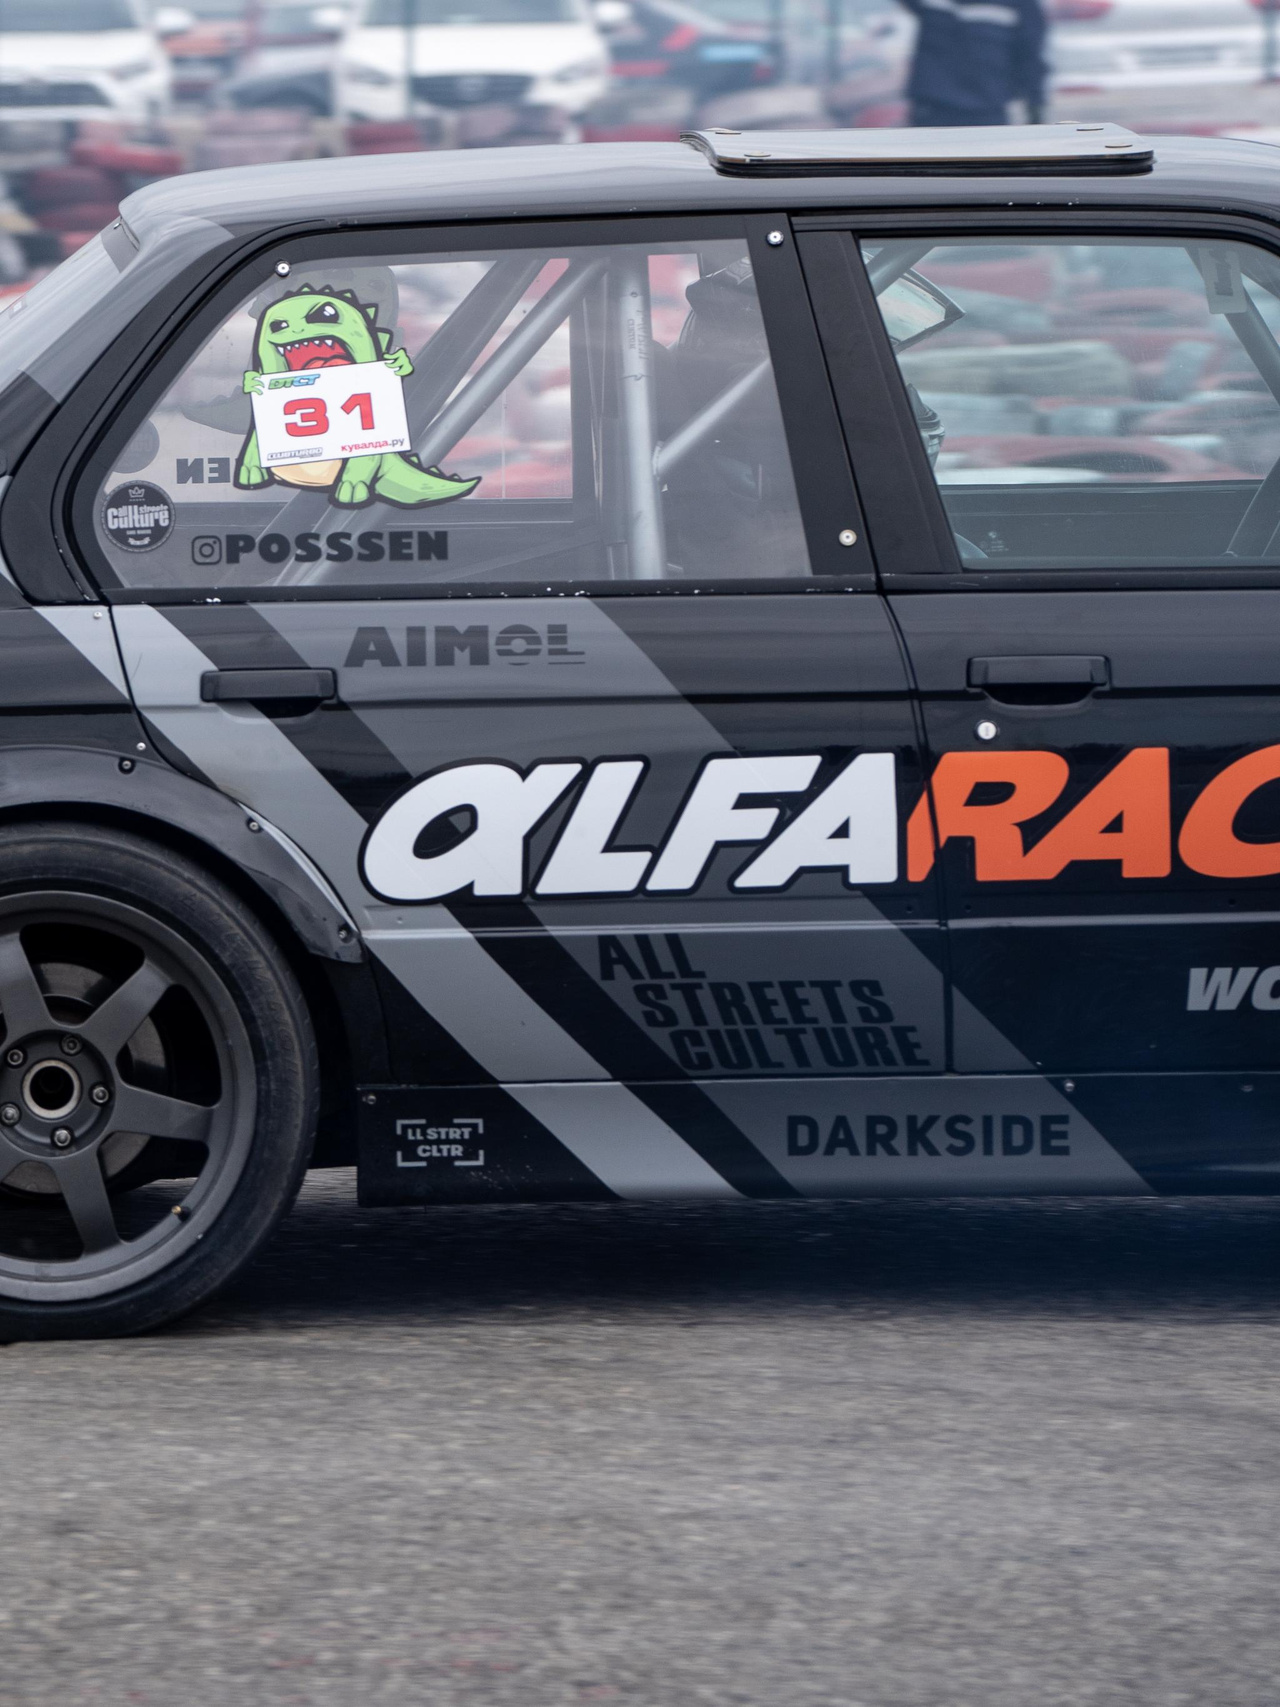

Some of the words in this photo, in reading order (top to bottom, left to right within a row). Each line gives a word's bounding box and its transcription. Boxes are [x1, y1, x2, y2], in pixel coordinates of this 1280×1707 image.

[283, 392, 375, 437] 31
[341, 438, 405, 453] кувалда.ру
[107, 505, 170, 530] Culture
[226, 531, 448, 564] POSSSEN
[343, 624, 586, 668] AIMOL
[598, 933, 707, 981] ALL
[632, 979, 894, 1028] STREETS
[669, 1025, 932, 1071] CULTURE
[417, 1144, 464, 1157] CLTR
[426, 1127, 472, 1140] STRT
[787, 1114, 1071, 1157] DARKSIDE
